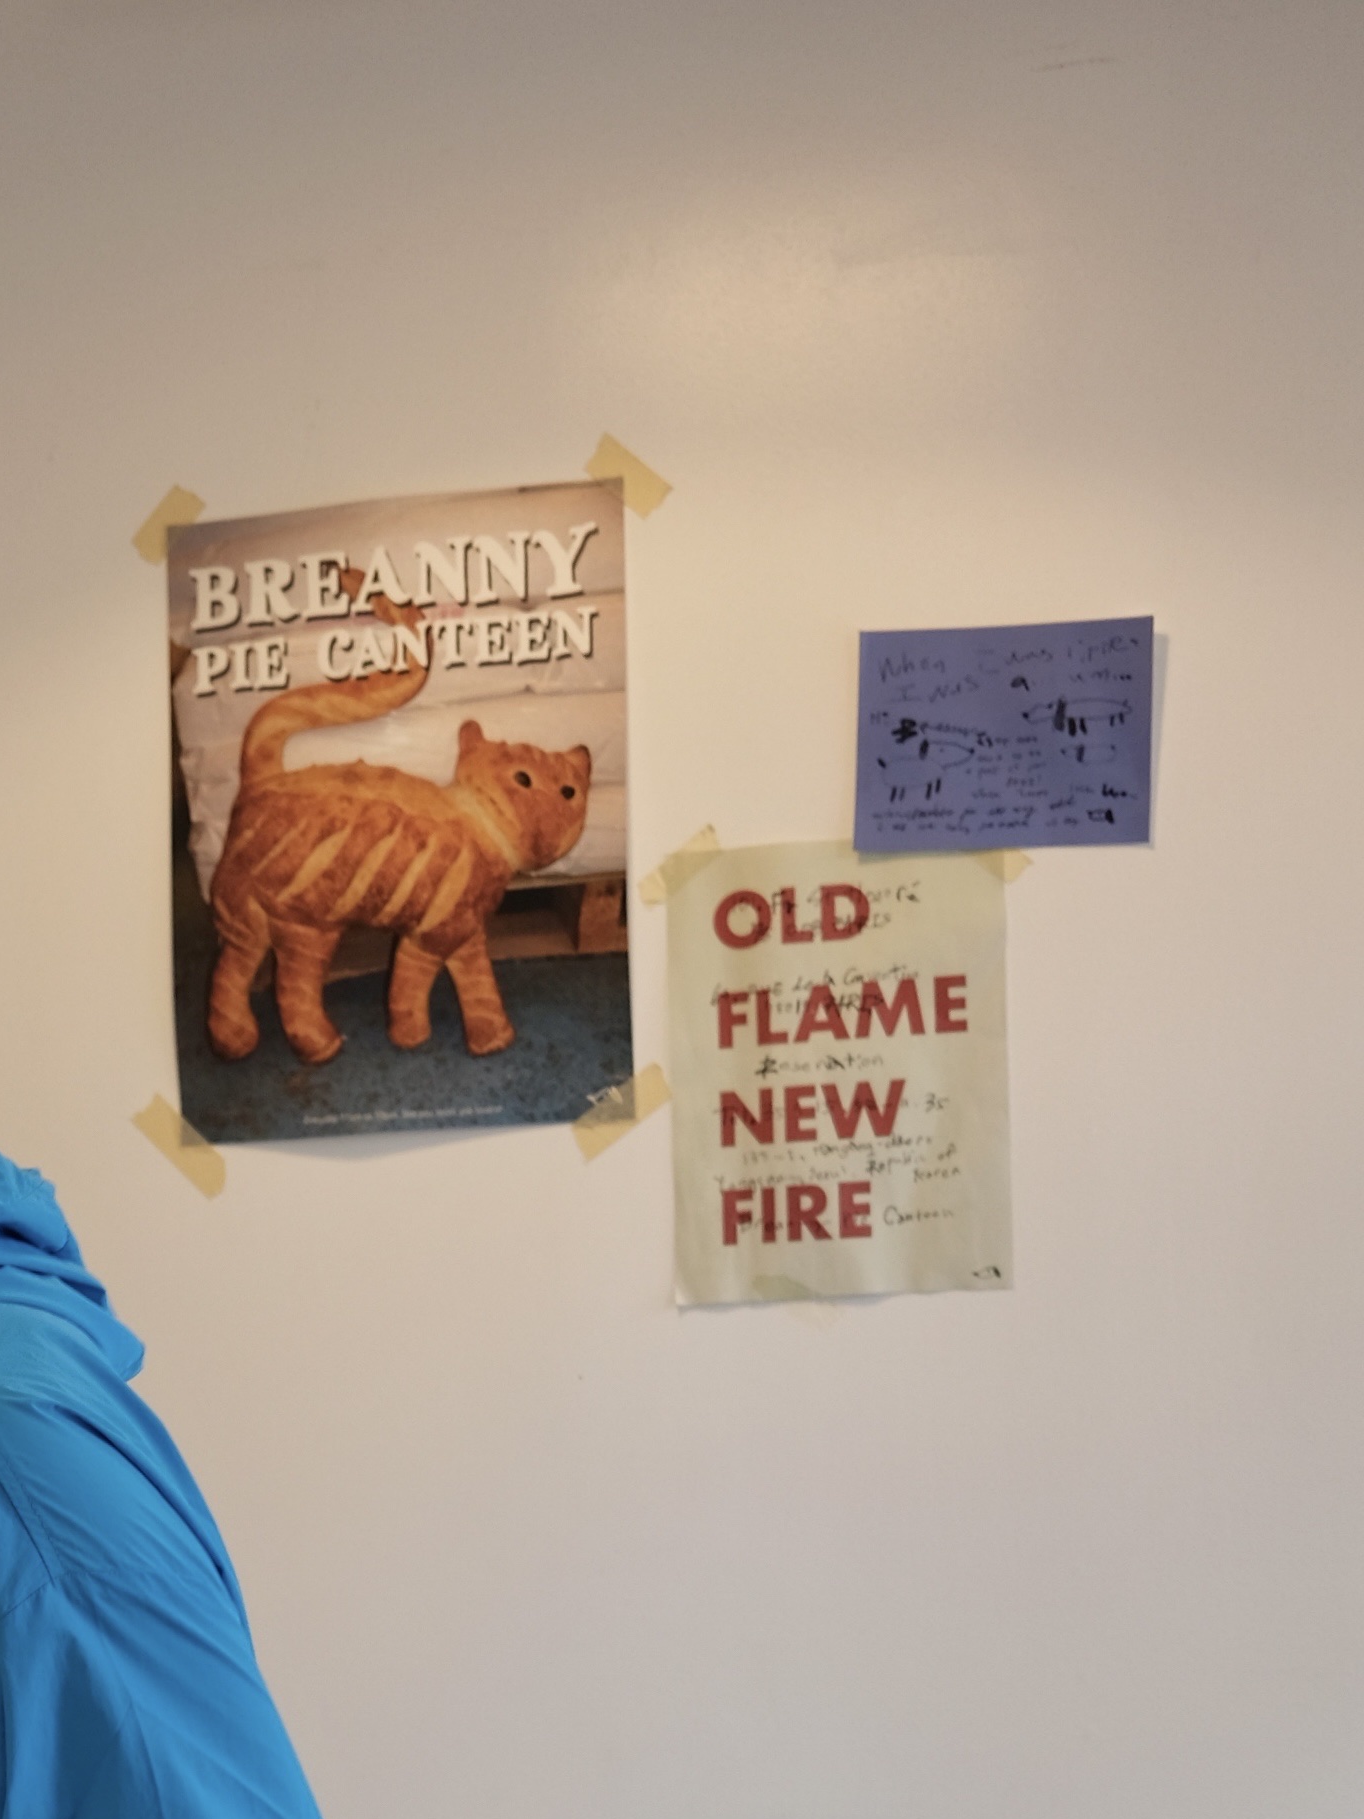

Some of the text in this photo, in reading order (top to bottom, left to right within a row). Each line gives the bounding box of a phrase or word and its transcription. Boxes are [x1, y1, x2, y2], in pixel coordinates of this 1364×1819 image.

[189, 521, 599, 633] BREANNY
[190, 606, 599, 697] PIE CANTEEN
[713, 883, 870, 950] OLD
[717, 975, 969, 1050] FLAME
[719, 1078, 906, 1148] NEW
[722, 1180, 873, 1247] FIRE
